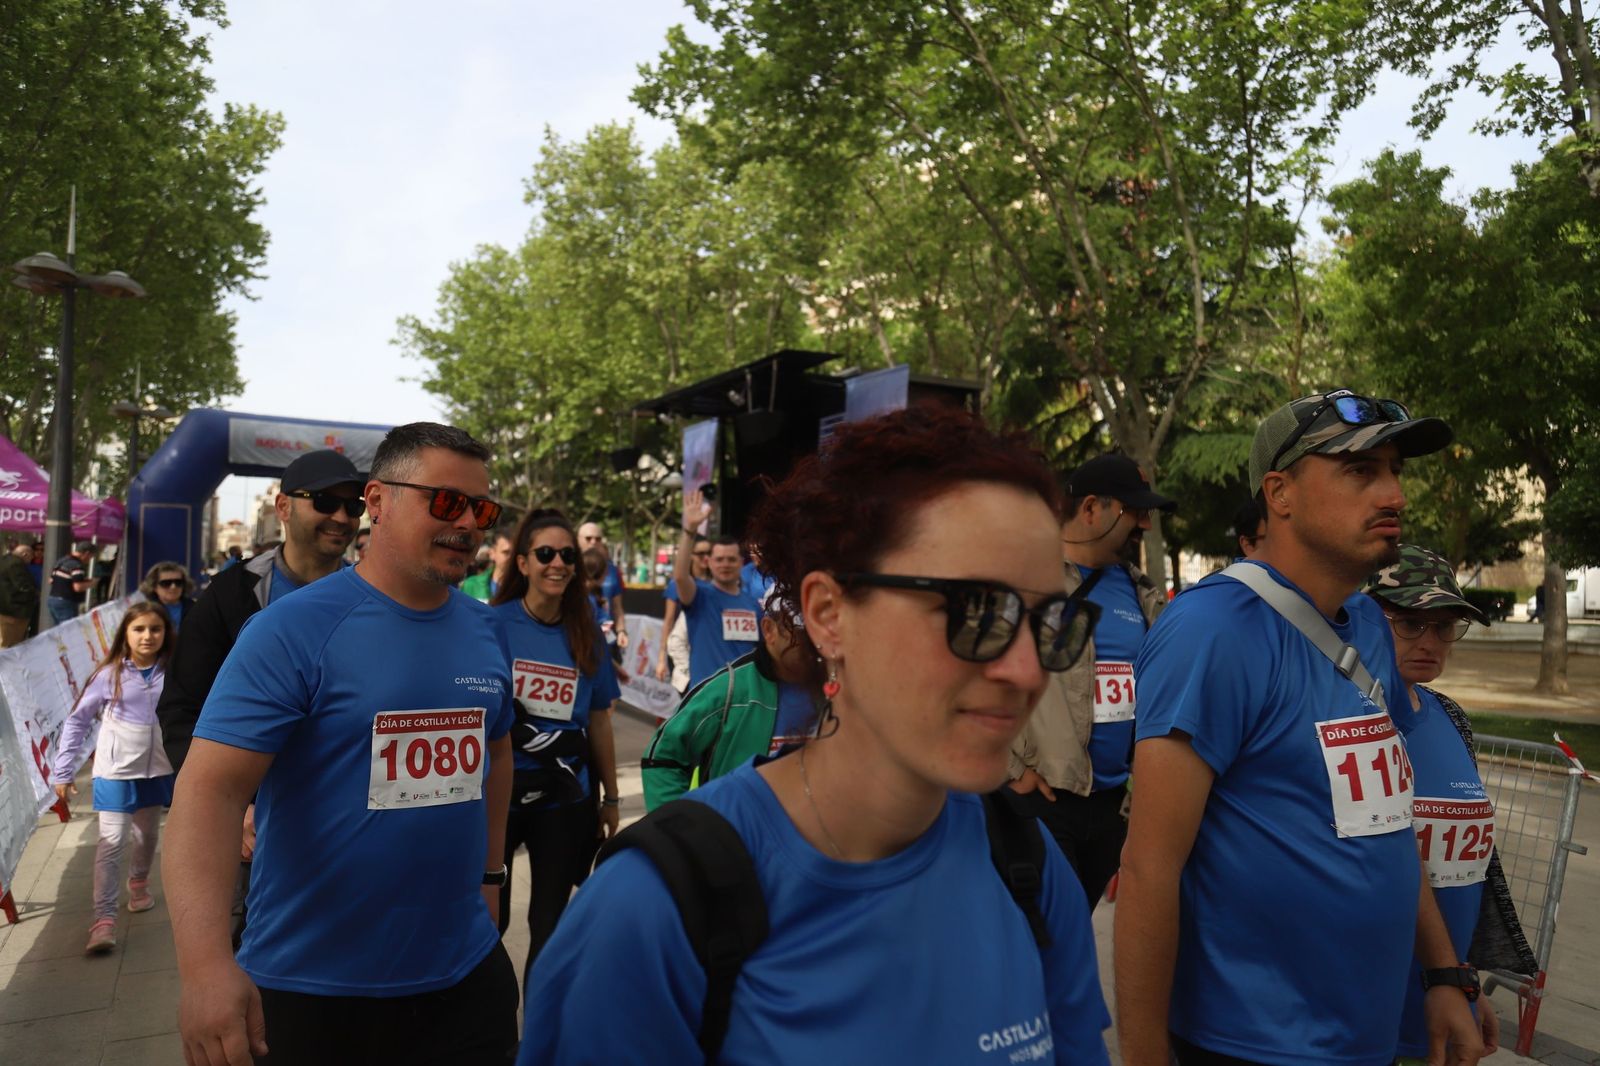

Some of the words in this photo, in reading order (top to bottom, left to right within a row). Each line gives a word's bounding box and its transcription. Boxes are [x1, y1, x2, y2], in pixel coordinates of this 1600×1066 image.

[454, 677, 487, 685] CASTILLA
[515, 675, 574, 705] 1236
[380, 717, 398, 729] DÍA
[400, 719, 412, 727] DE
[414, 717, 450, 727] CASTILLA
[458, 715, 480, 724] LEÓN
[1326, 727, 1350, 740] DÍA
[1351, 726, 1367, 737] DE
[380, 734, 481, 781] 1080
[1337, 743, 1414, 802] 1124
[1414, 803, 1431, 813] DÍA
[1433, 805, 1445, 814] DE
[1446, 806, 1479, 815] CASTILLA
[1479, 806, 1484, 814] Y
[1416, 823, 1494, 862] 1125
[978, 1016, 1044, 1052] CASTILLA
